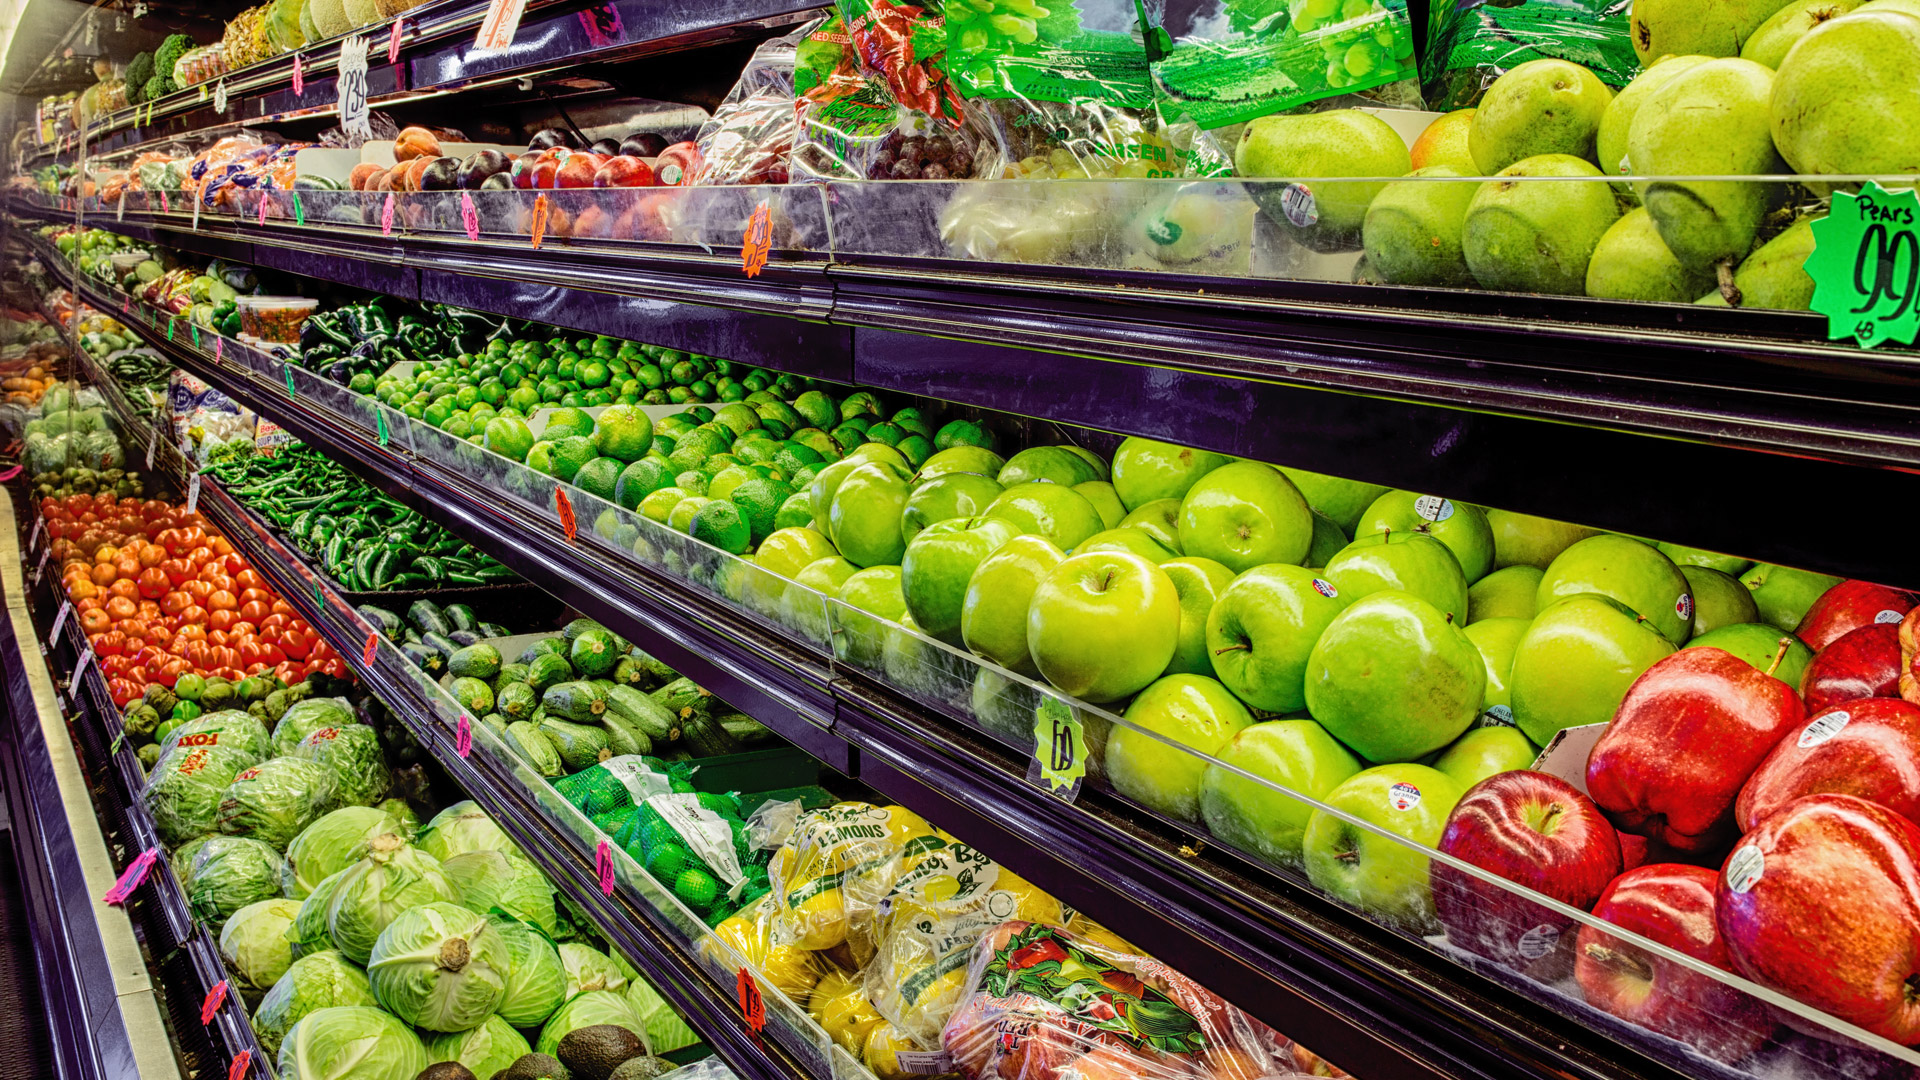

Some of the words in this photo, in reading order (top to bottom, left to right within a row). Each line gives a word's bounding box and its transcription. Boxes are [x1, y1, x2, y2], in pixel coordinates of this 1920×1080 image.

[811, 32, 829, 42] RED
[1095, 143, 1167, 162] GREEN
[1855, 195, 1914, 224] Pears
[177, 732, 219, 748] FOXY
[1051, 719, 1074, 772] 69
[1393, 790, 1418, 802] Granny
[818, 824, 885, 849] LEMONS
